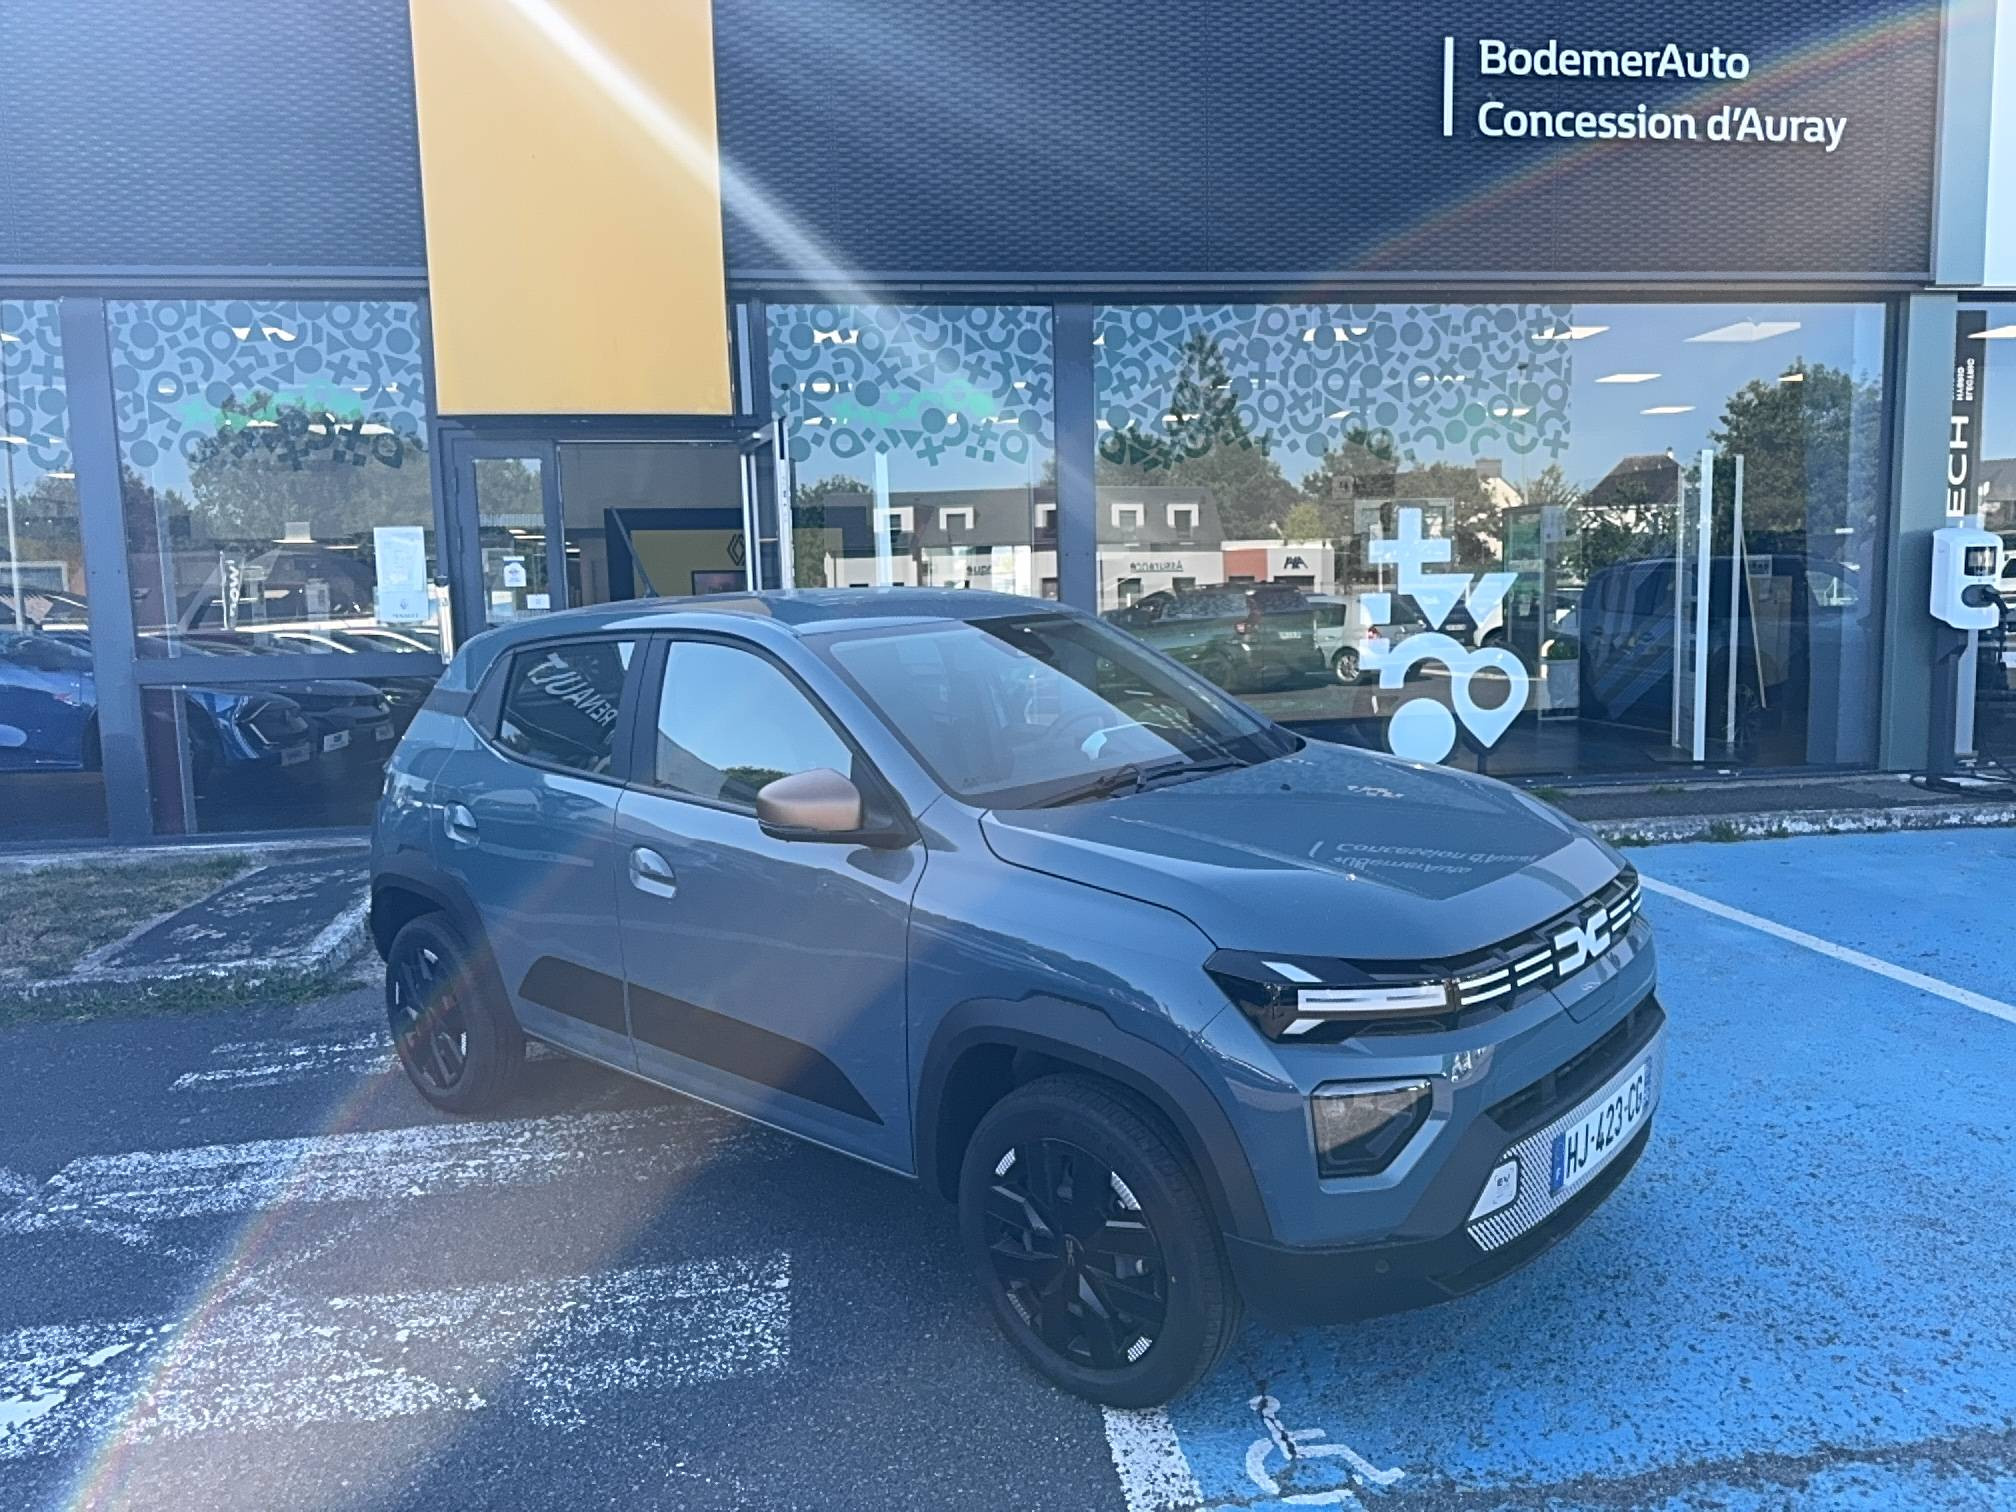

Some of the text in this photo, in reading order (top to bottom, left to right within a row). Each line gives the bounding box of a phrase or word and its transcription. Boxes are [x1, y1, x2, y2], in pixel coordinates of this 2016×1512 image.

[1479, 39, 1750, 79] BodemerAuto
[1477, 101, 1847, 152] Concession d'Auray
[1565, 1075, 1643, 1179] HJ-423-CG
